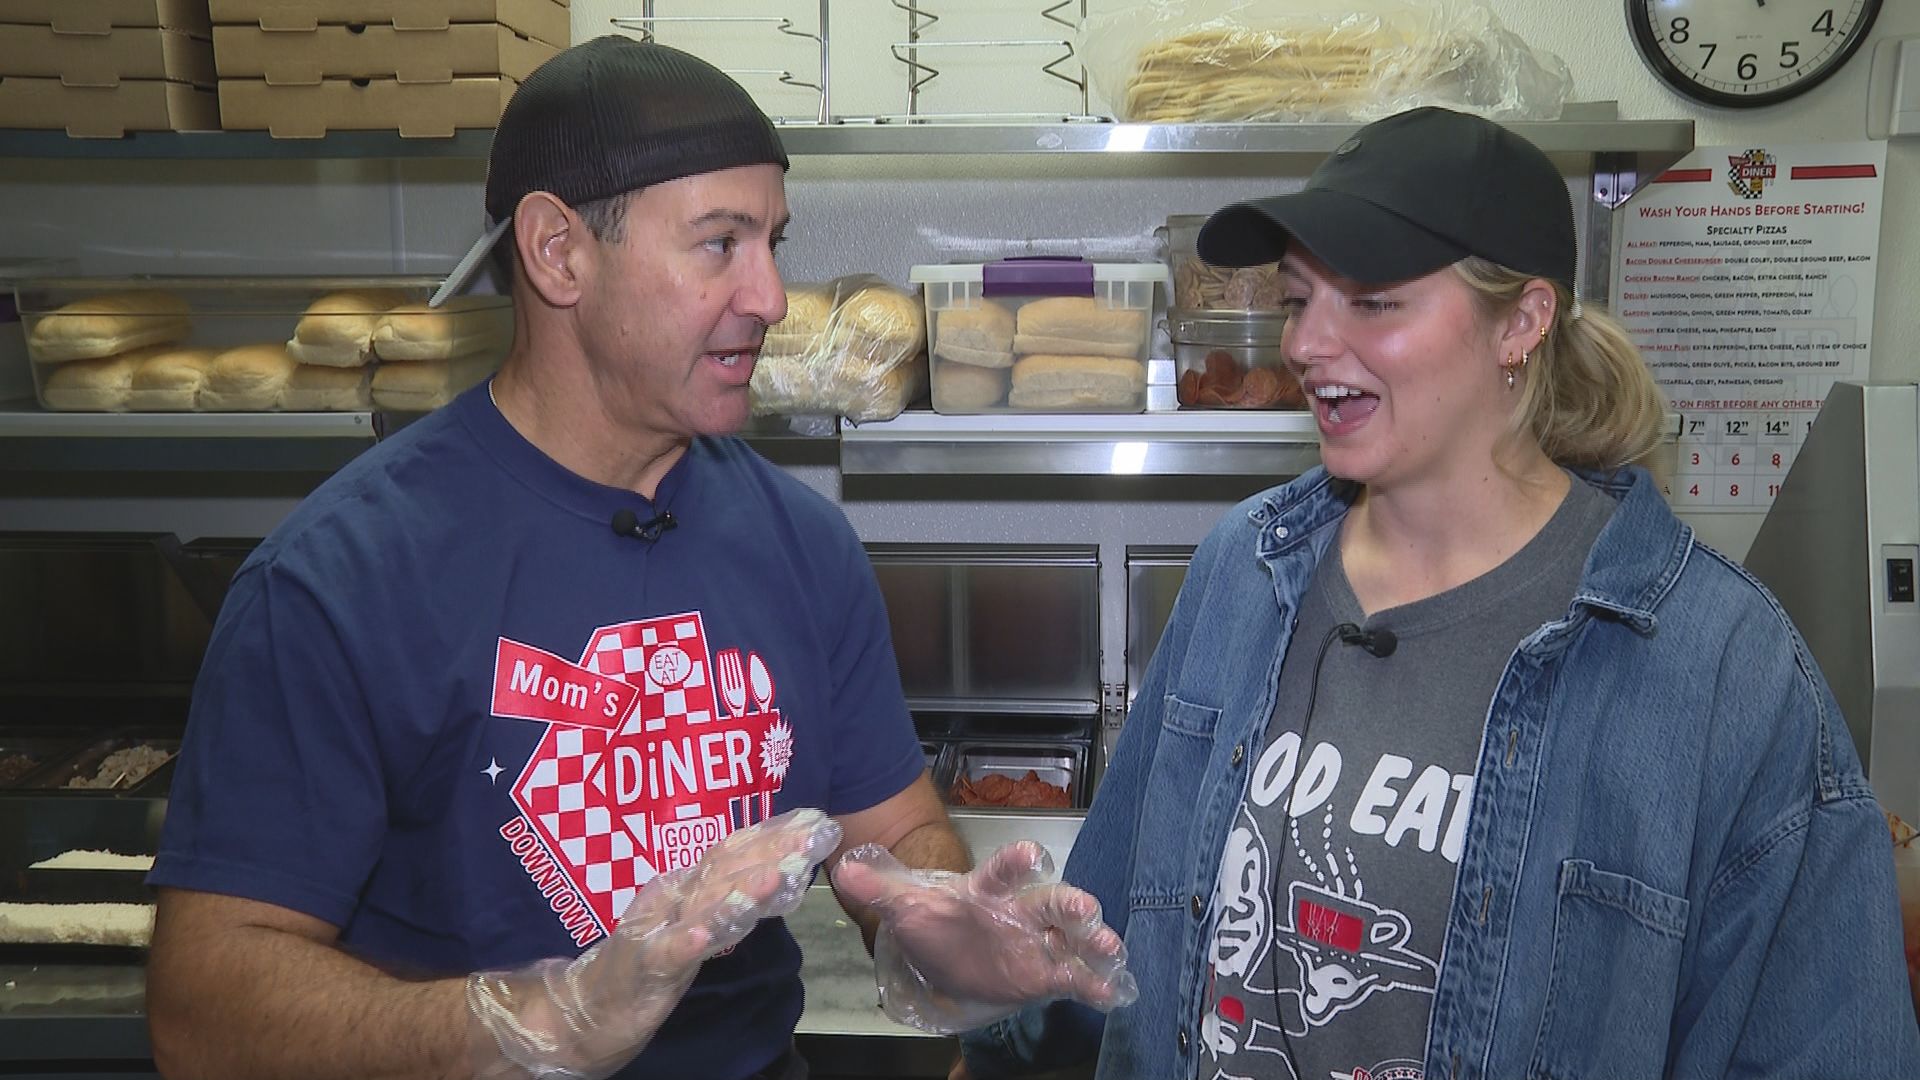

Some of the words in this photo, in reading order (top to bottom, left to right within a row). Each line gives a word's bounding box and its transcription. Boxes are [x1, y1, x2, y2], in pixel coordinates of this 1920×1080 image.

[1669, 16, 1690, 44] 8
[1811, 9, 1835, 37] 4
[1698, 43, 1717, 70] 7
[1736, 53, 1757, 81] 6
[1779, 41, 1800, 68] 5
[1742, 167, 1773, 178] DINER
[1639, 207, 1671, 218] WASH
[1675, 206, 1707, 217] YOUR
[1710, 205, 1751, 216] HANDS
[1755, 204, 1800, 215] BEFORE
[1804, 202, 1865, 214] STARTING!
[1706, 225, 1754, 236] SPECIALTY
[1756, 225, 1787, 234] PIZZAS
[1680, 400, 1694, 409] ON
[1697, 400, 1720, 409] FIRST
[1723, 400, 1759, 409] BEFORE
[1761, 400, 1780, 408] ANY
[1782, 400, 1813, 408] OTHER
[1692, 453, 1700, 465] 3
[1732, 453, 1740, 465] 6
[1772, 453, 1781, 466] 8
[1689, 485, 1699, 496] 4
[1730, 485, 1739, 496] 8
[654, 652, 681, 670] EAT
[509, 658, 621, 718] Mom's
[660, 668, 679, 685] AT
[1250, 731, 1343, 818] OD
[665, 822, 717, 848] GOOD
[669, 845, 713, 870] FOO
[499, 816, 602, 948] DOWNTOWN
